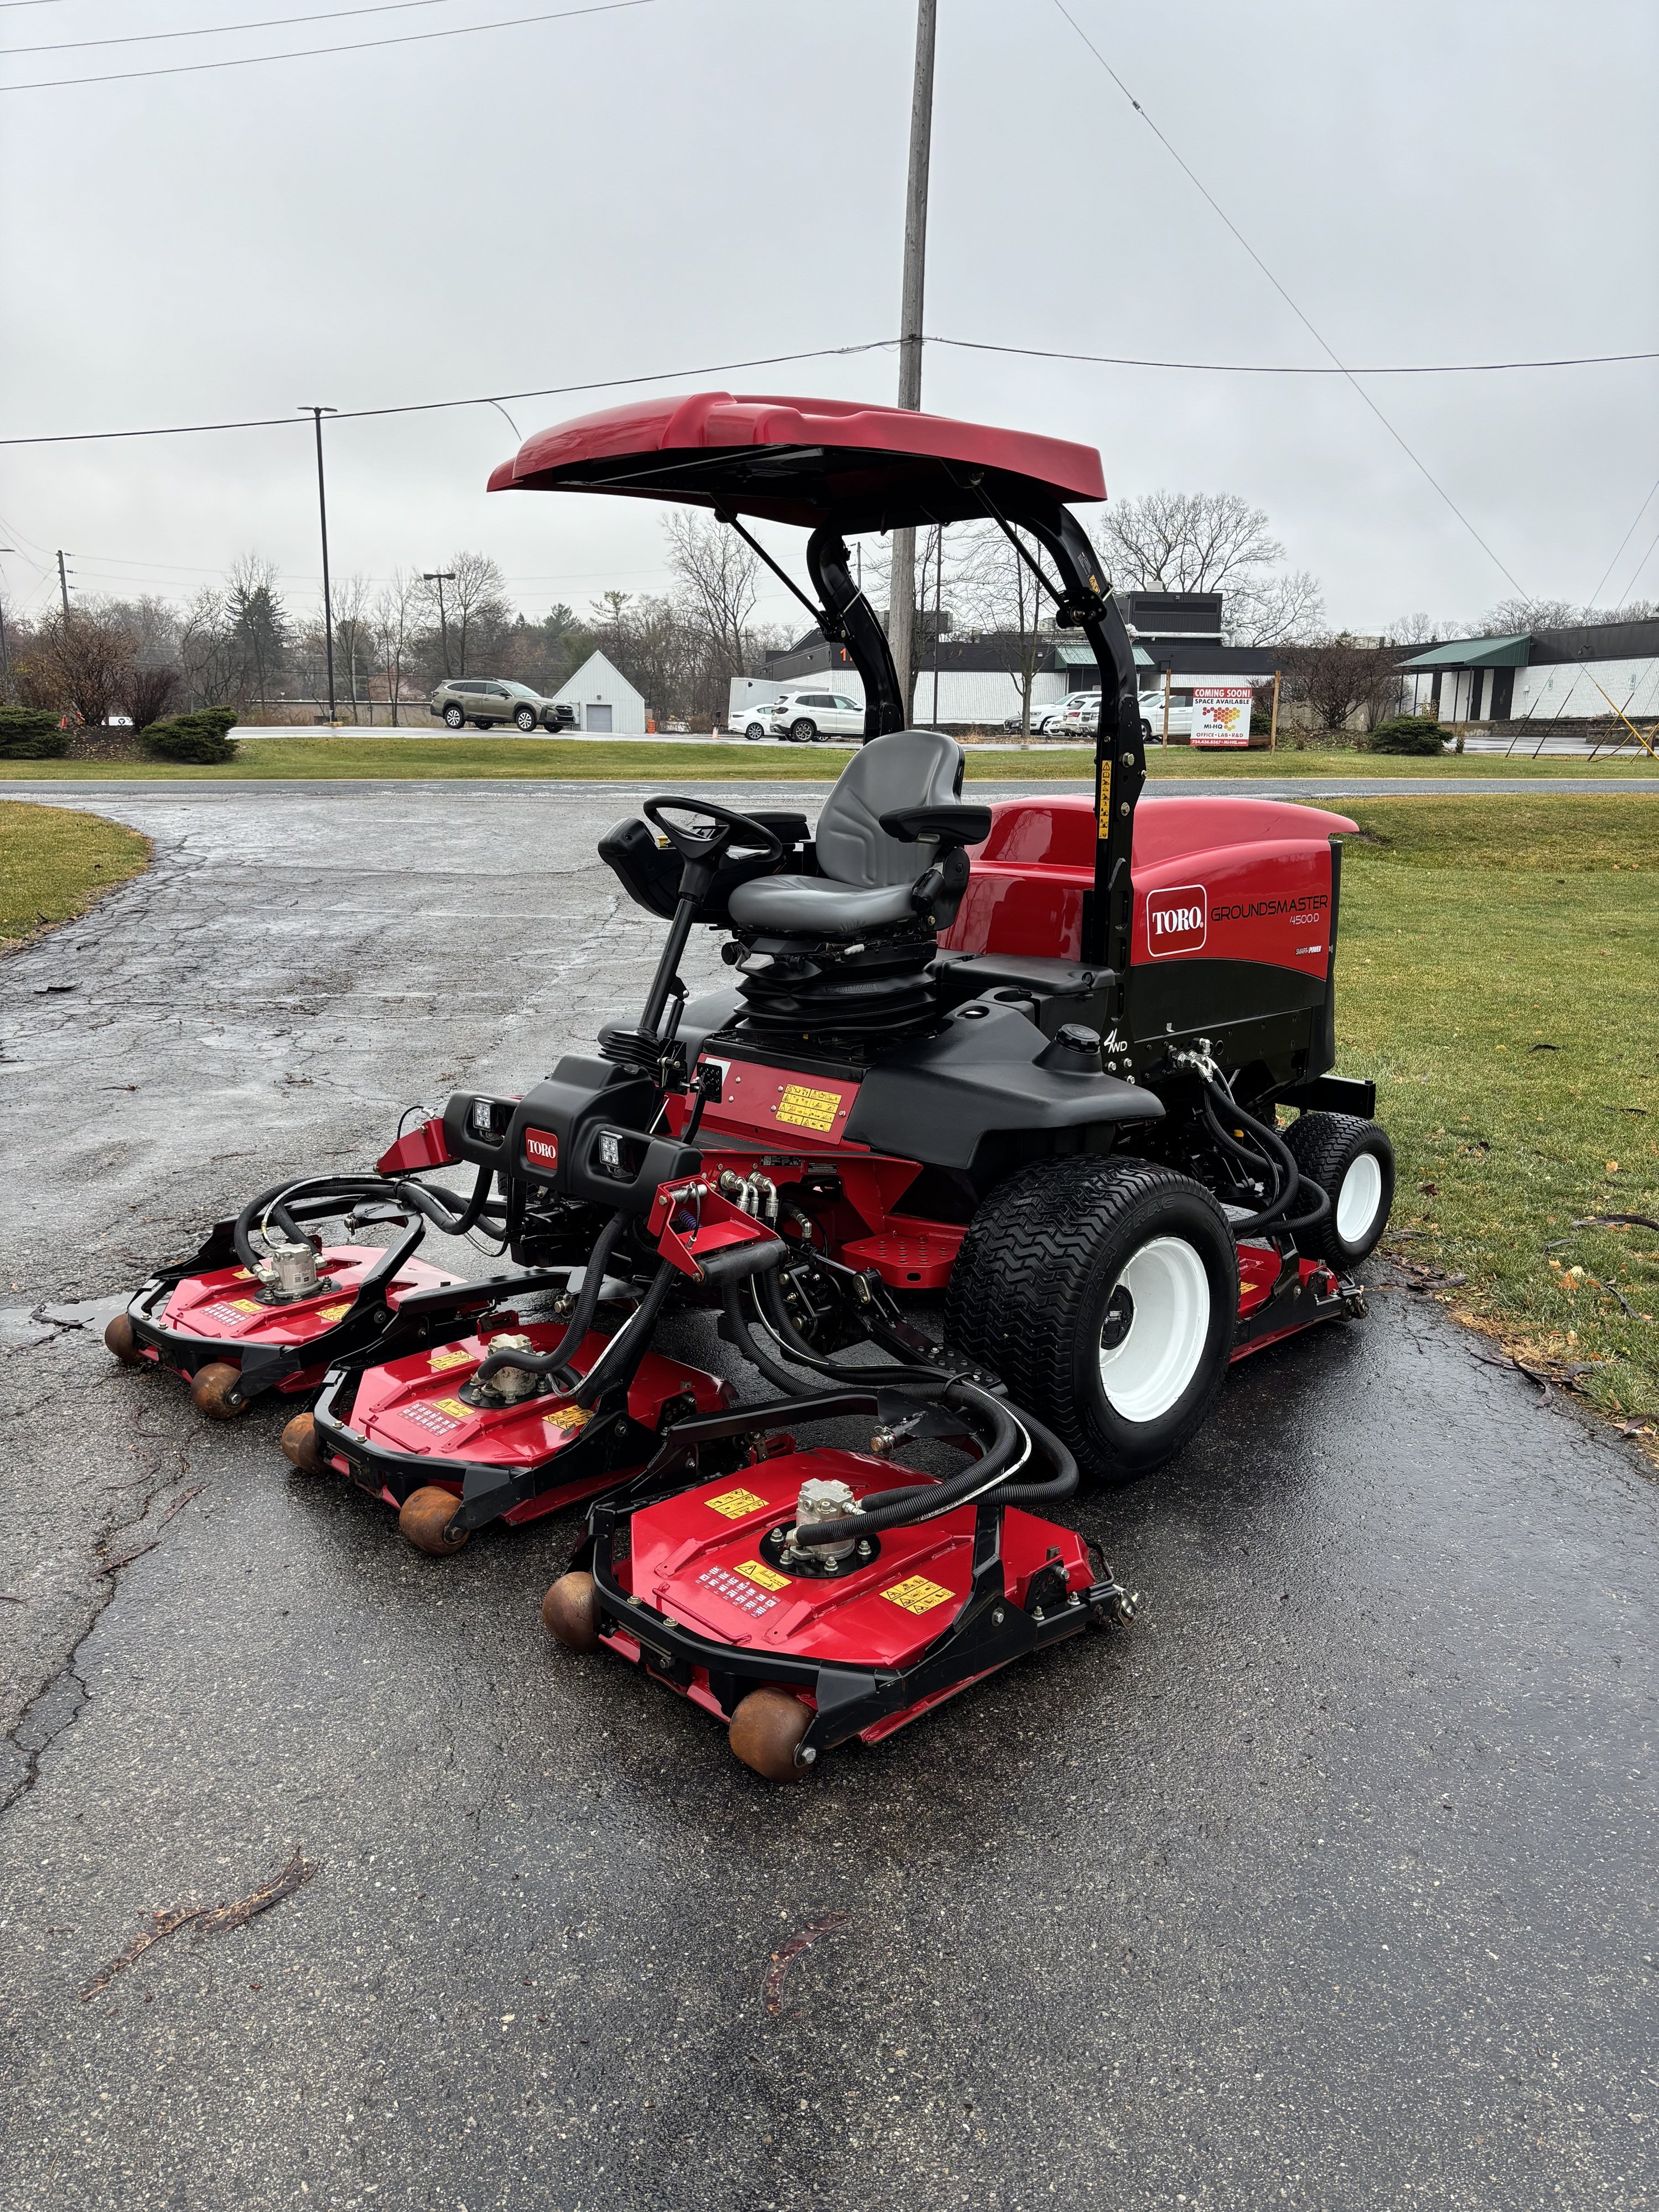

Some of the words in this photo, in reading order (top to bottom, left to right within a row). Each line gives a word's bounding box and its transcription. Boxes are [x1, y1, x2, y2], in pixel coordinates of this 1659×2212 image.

[1195, 689, 1225, 697] COMING
[1152, 906, 1201, 935] TORO
[1210, 894, 1328, 922] GROUNDSMASTER
[1103, 1027, 1128, 1053] 4WD
[527, 1139, 556, 1159] TORO
